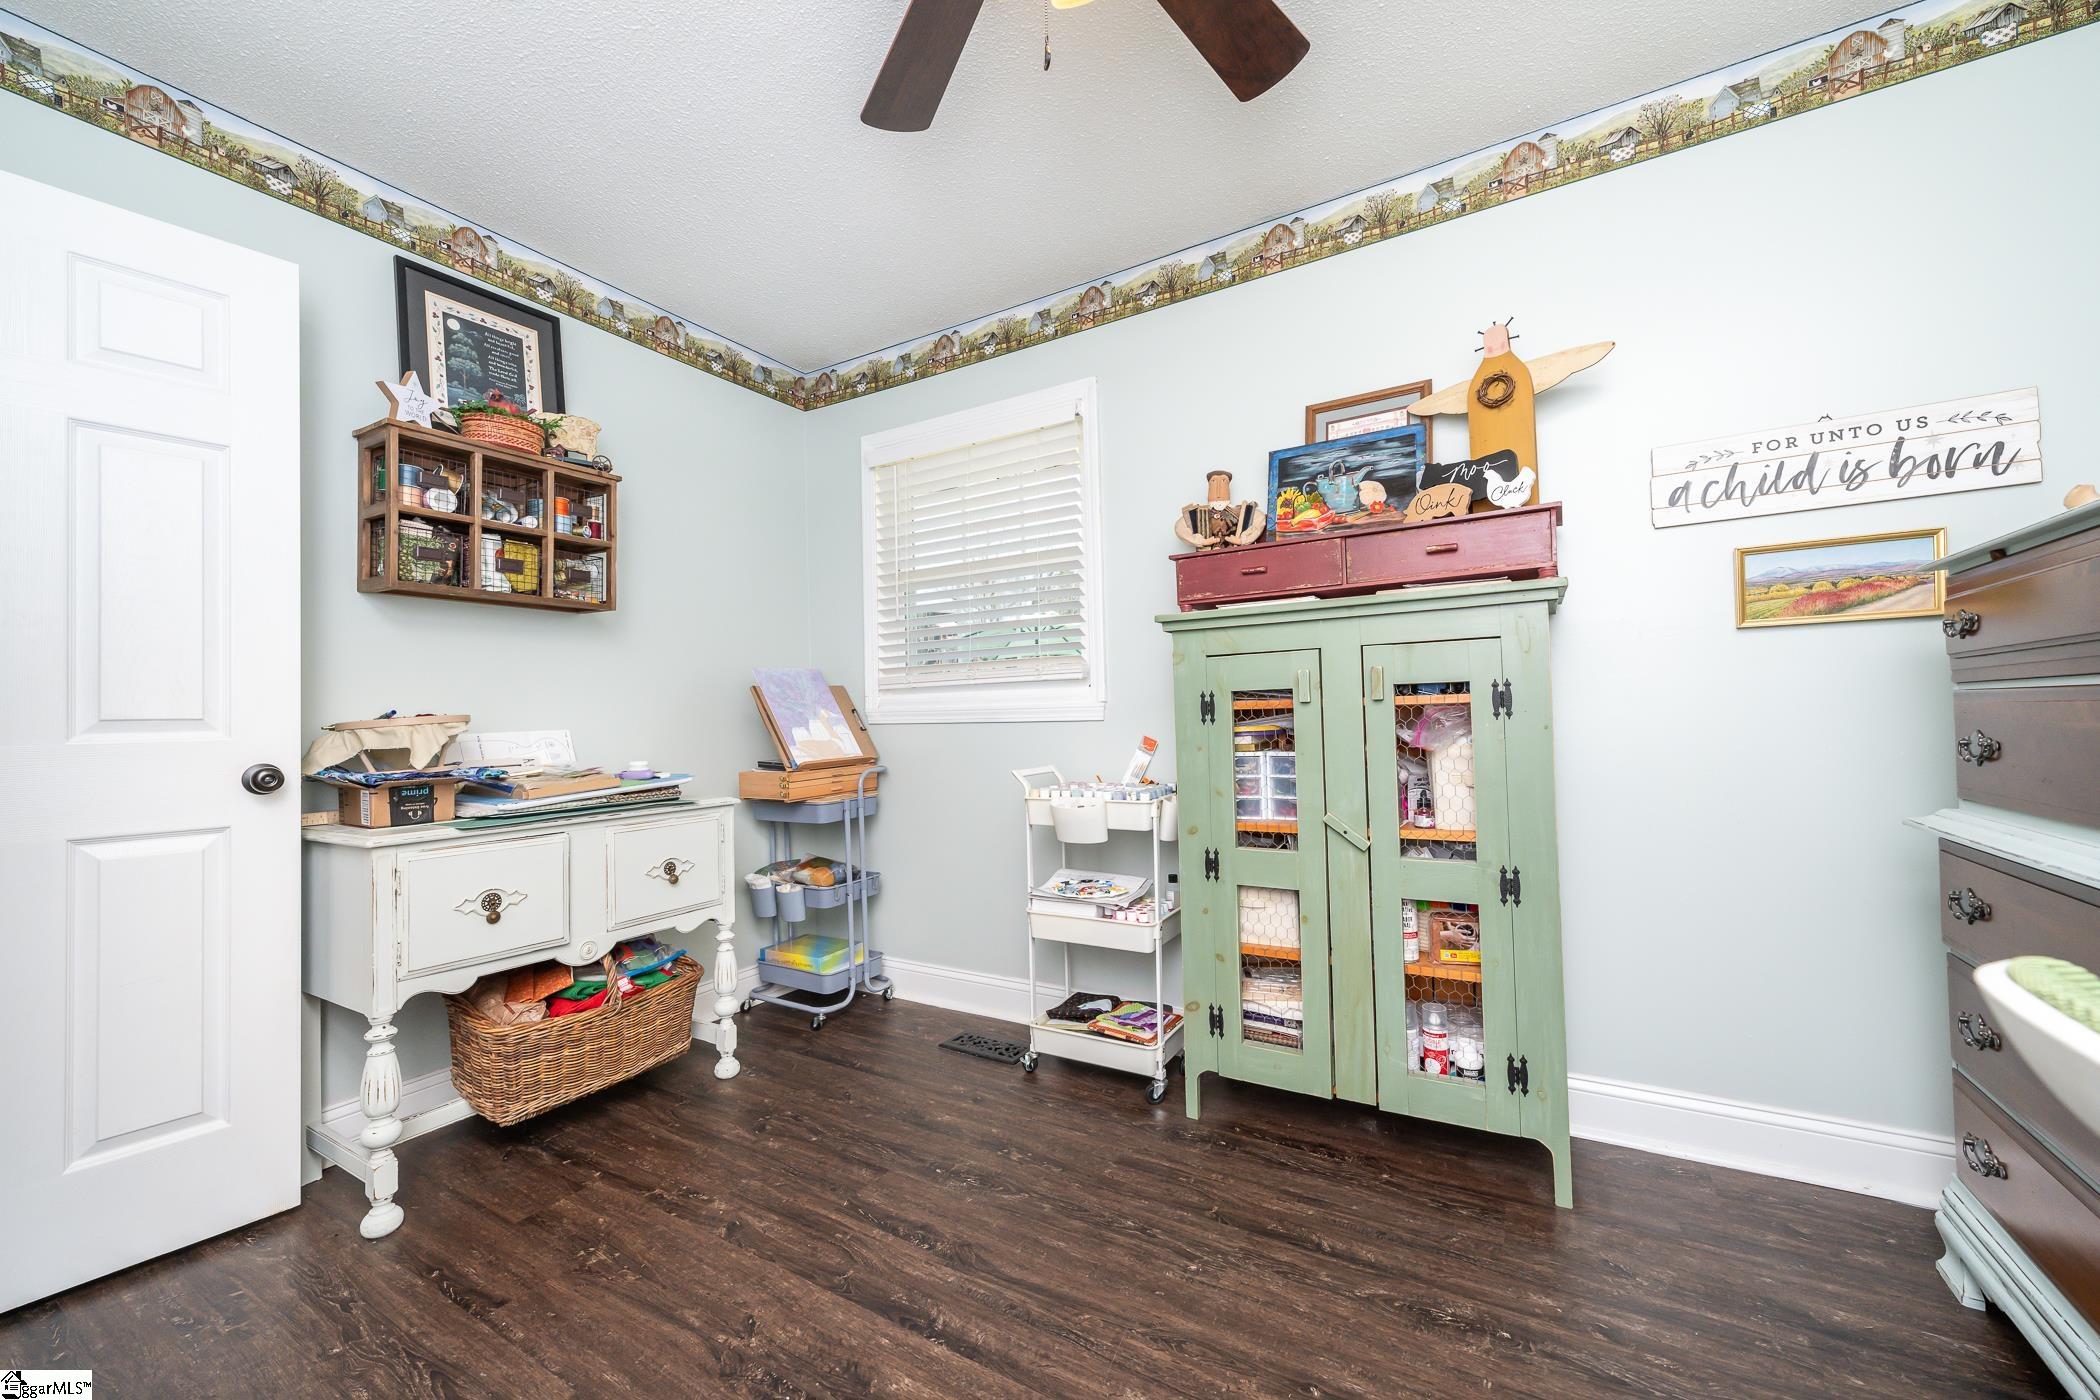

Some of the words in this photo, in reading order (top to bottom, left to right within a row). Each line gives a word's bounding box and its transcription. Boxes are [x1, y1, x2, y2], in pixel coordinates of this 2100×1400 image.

[403, 389, 428, 409] Joy
[405, 410, 427, 421] WORLD
[1752, 437, 1798, 453] FOR
[1811, 423, 1882, 444] UNTO
[1896, 416, 1929, 431] US
[1668, 480, 1692, 513] a
[1701, 451, 1831, 508] child
[1839, 451, 1884, 491] is
[1889, 436, 2022, 488] born
[1415, 488, 1463, 515] Oink
[1491, 481, 1528, 502] Cluck
[401, 787, 429, 796] prime
